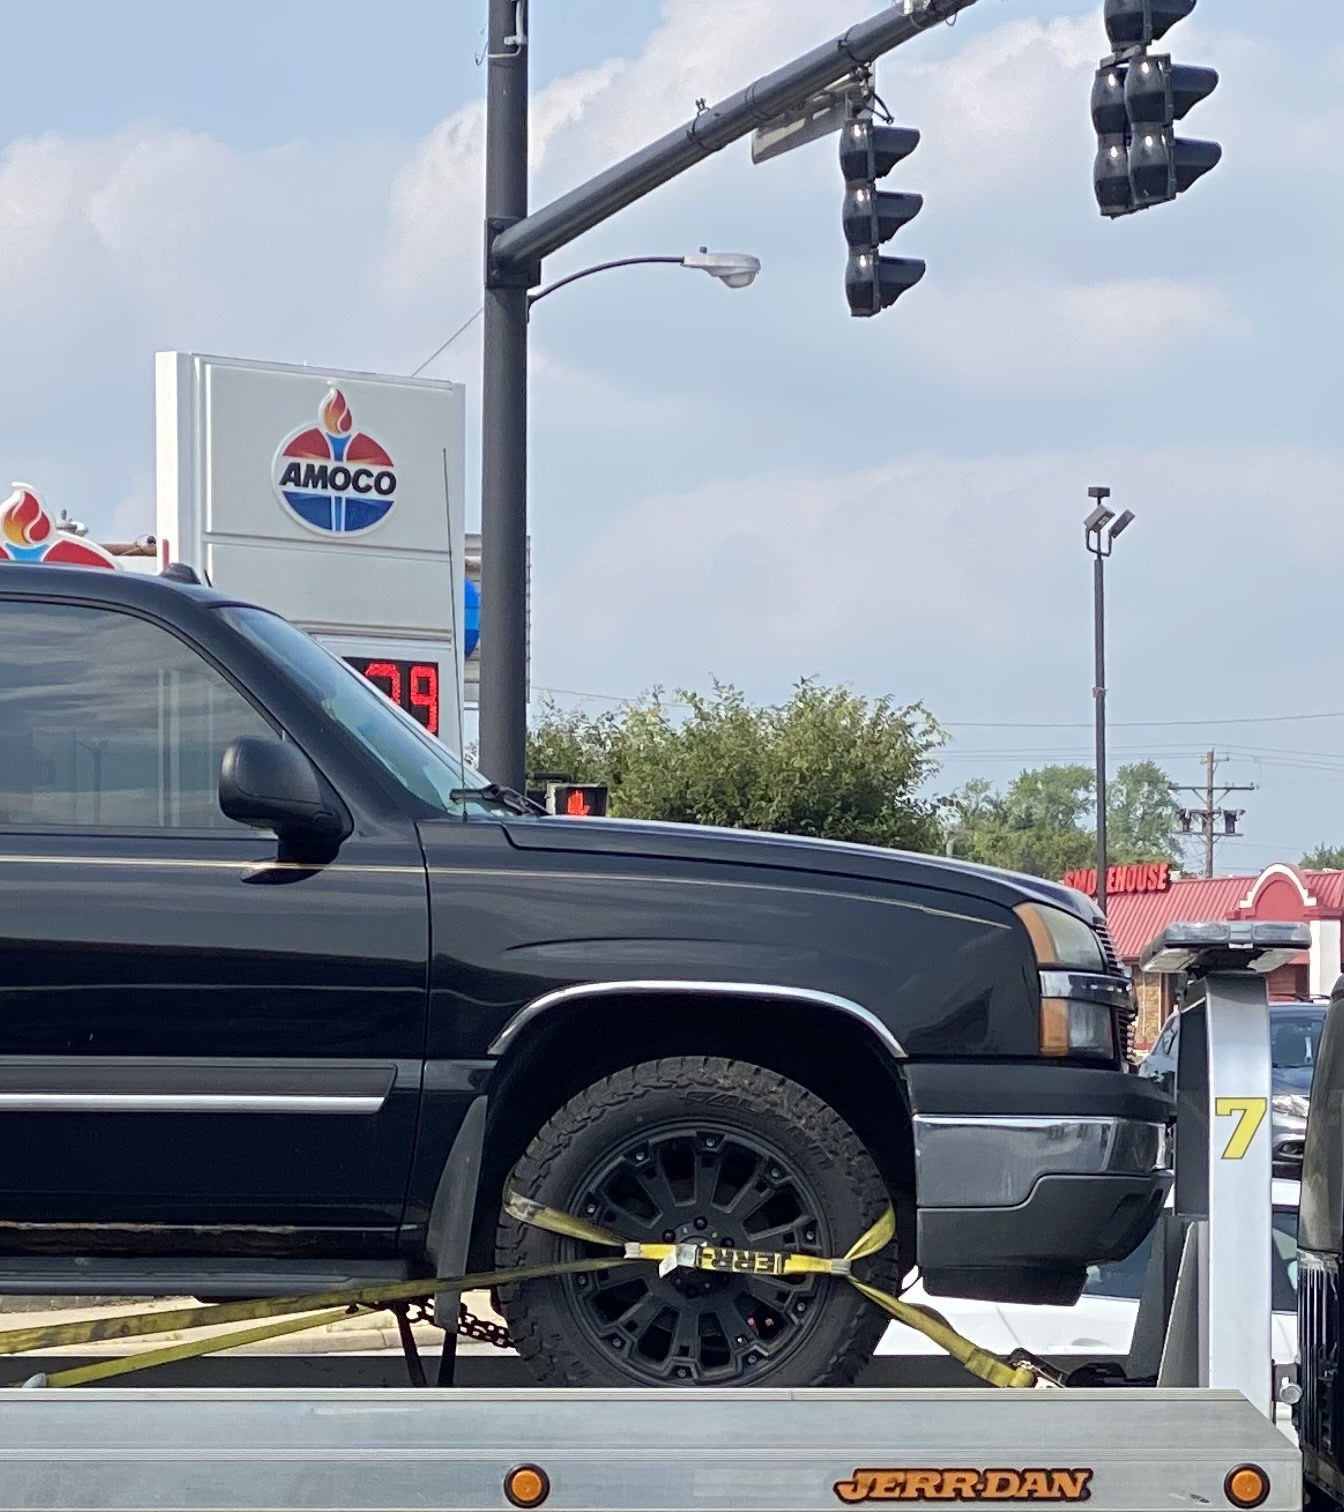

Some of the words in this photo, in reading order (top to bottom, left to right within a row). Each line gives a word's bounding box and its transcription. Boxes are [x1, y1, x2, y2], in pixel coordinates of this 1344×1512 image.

[279, 462, 397, 495] AMOCO
[1064, 863, 1168, 896] SMOEHOUSE
[1215, 1097, 1267, 1160] 7
[833, 1468, 1093, 1504] JERR-DAN
